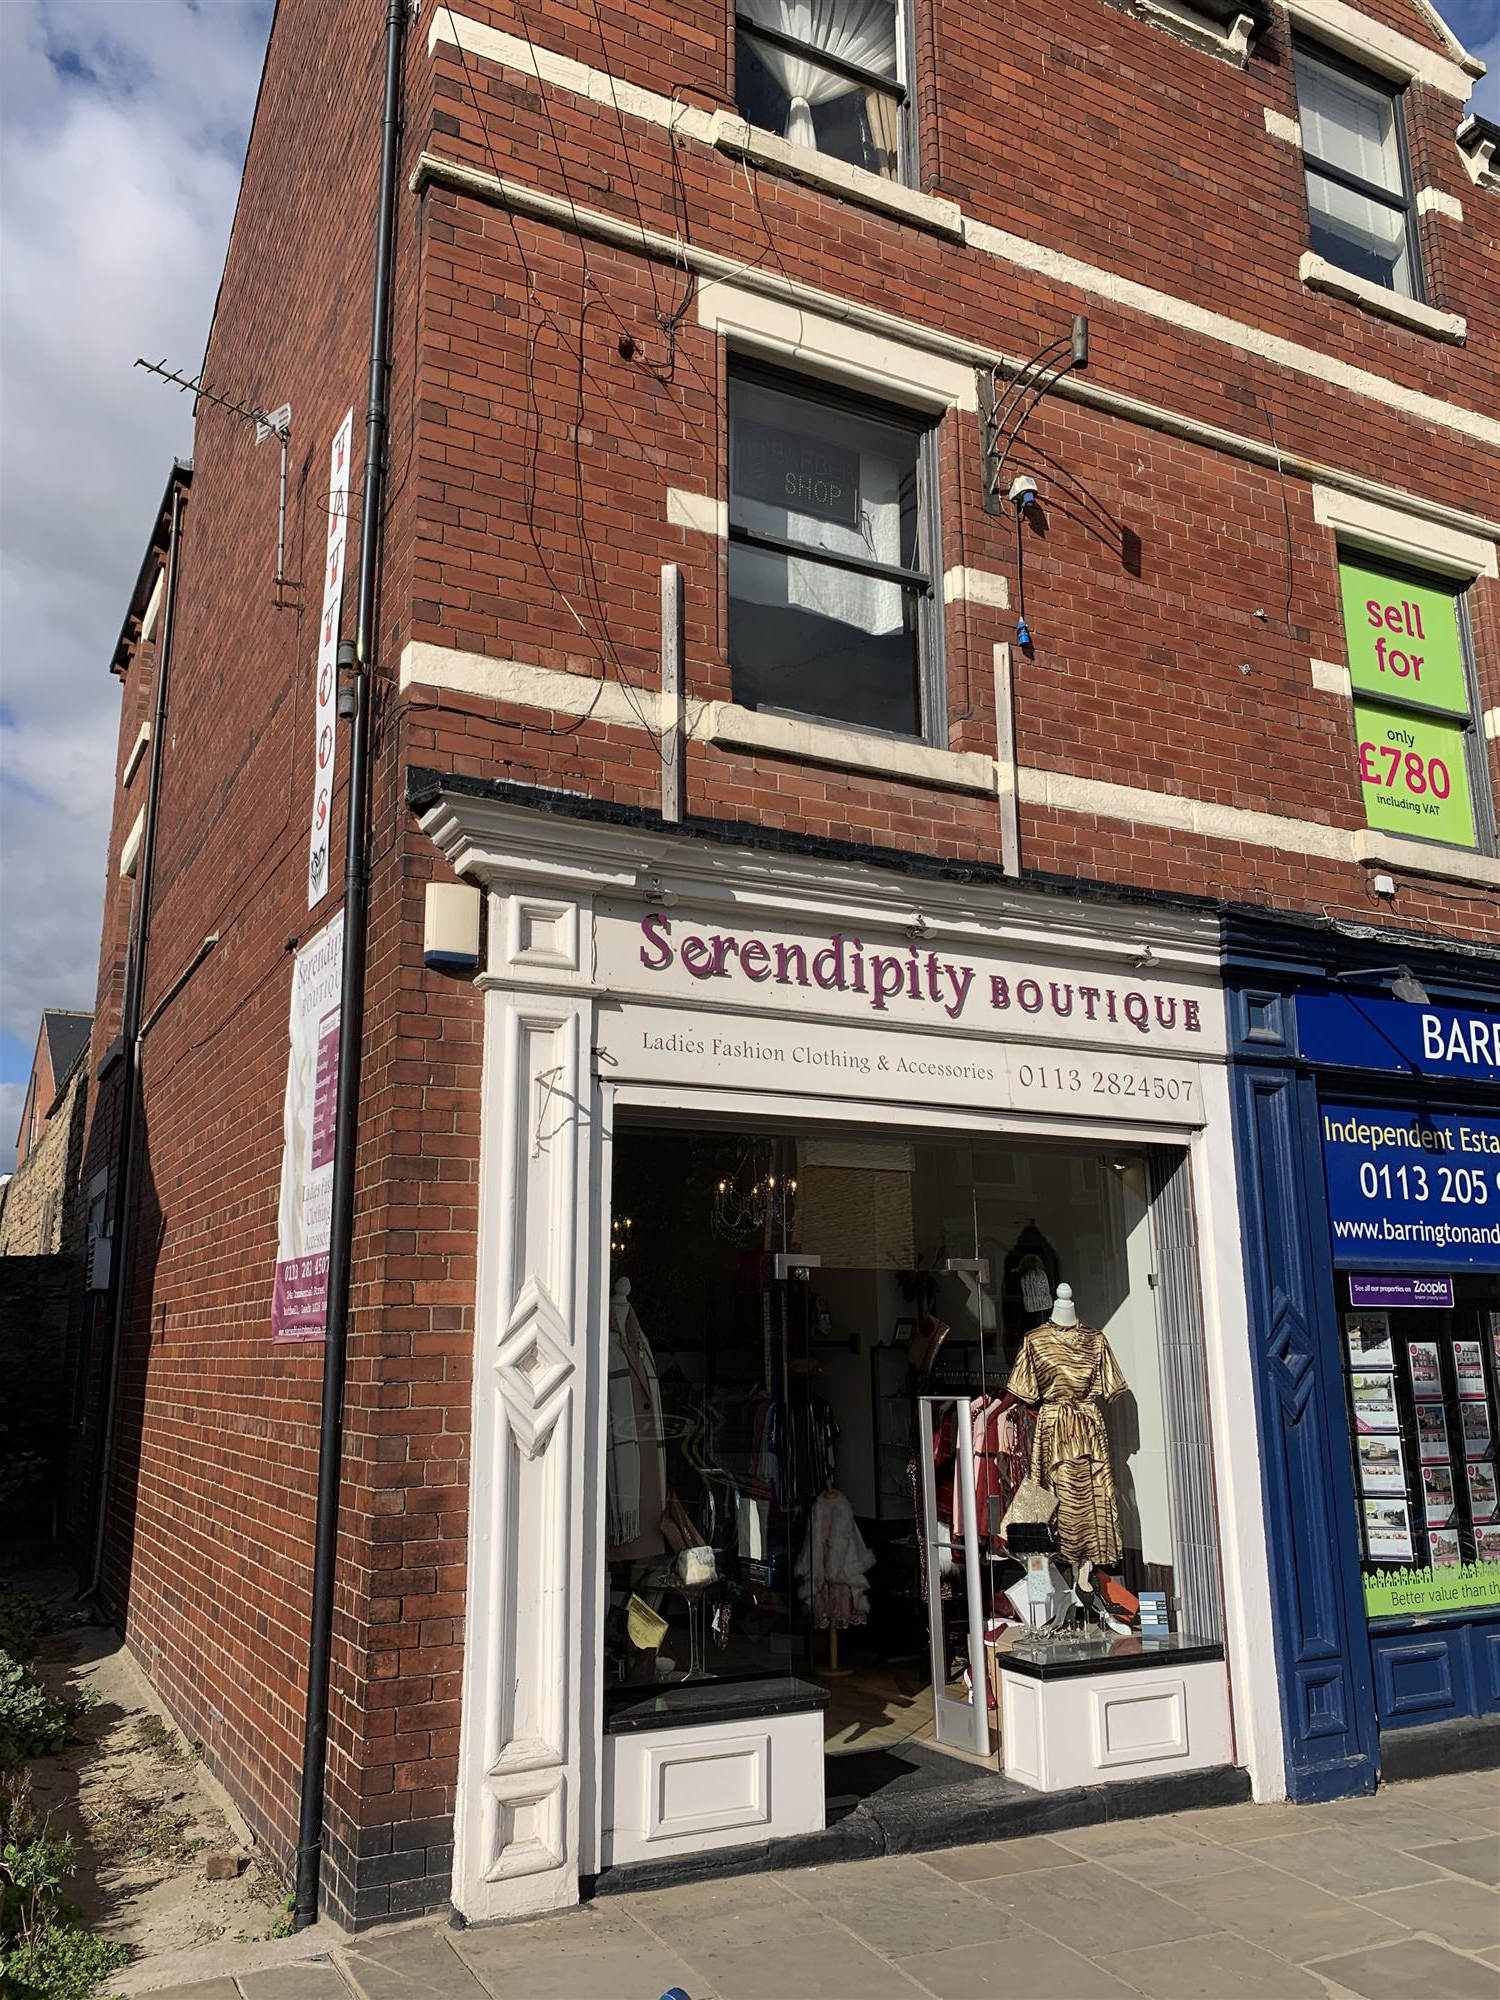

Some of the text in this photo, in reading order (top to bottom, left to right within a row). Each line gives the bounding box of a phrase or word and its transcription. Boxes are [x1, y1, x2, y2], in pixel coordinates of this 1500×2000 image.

[785, 472, 842, 506] SHOP
[1366, 600, 1425, 640] sell
[1375, 637, 1425, 681] for
[1387, 729, 1415, 748] only
[1360, 741, 1450, 800] £780
[1376, 793, 1440, 816] including VAT
[298, 931, 342, 990] Serendip
[639, 913, 1202, 1033] Serendipity BOUTIQUE
[301, 966, 342, 1017] BOUTIQU
[642, 1032, 995, 1081] Ladies Fashion Clothing & Accessories
[1018, 1063, 1194, 1103] 0113 2824507
[1324, 1115, 1455, 1151] Independent
[1360, 1161, 1429, 1202] 0113
[1437, 1167, 1488, 1205] 205
[1413, 1280, 1448, 1295] Zoopla
[1391, 1591, 1425, 1606] Better
[1429, 1587, 1459, 1602] value
[1461, 1583, 1486, 1599] than
